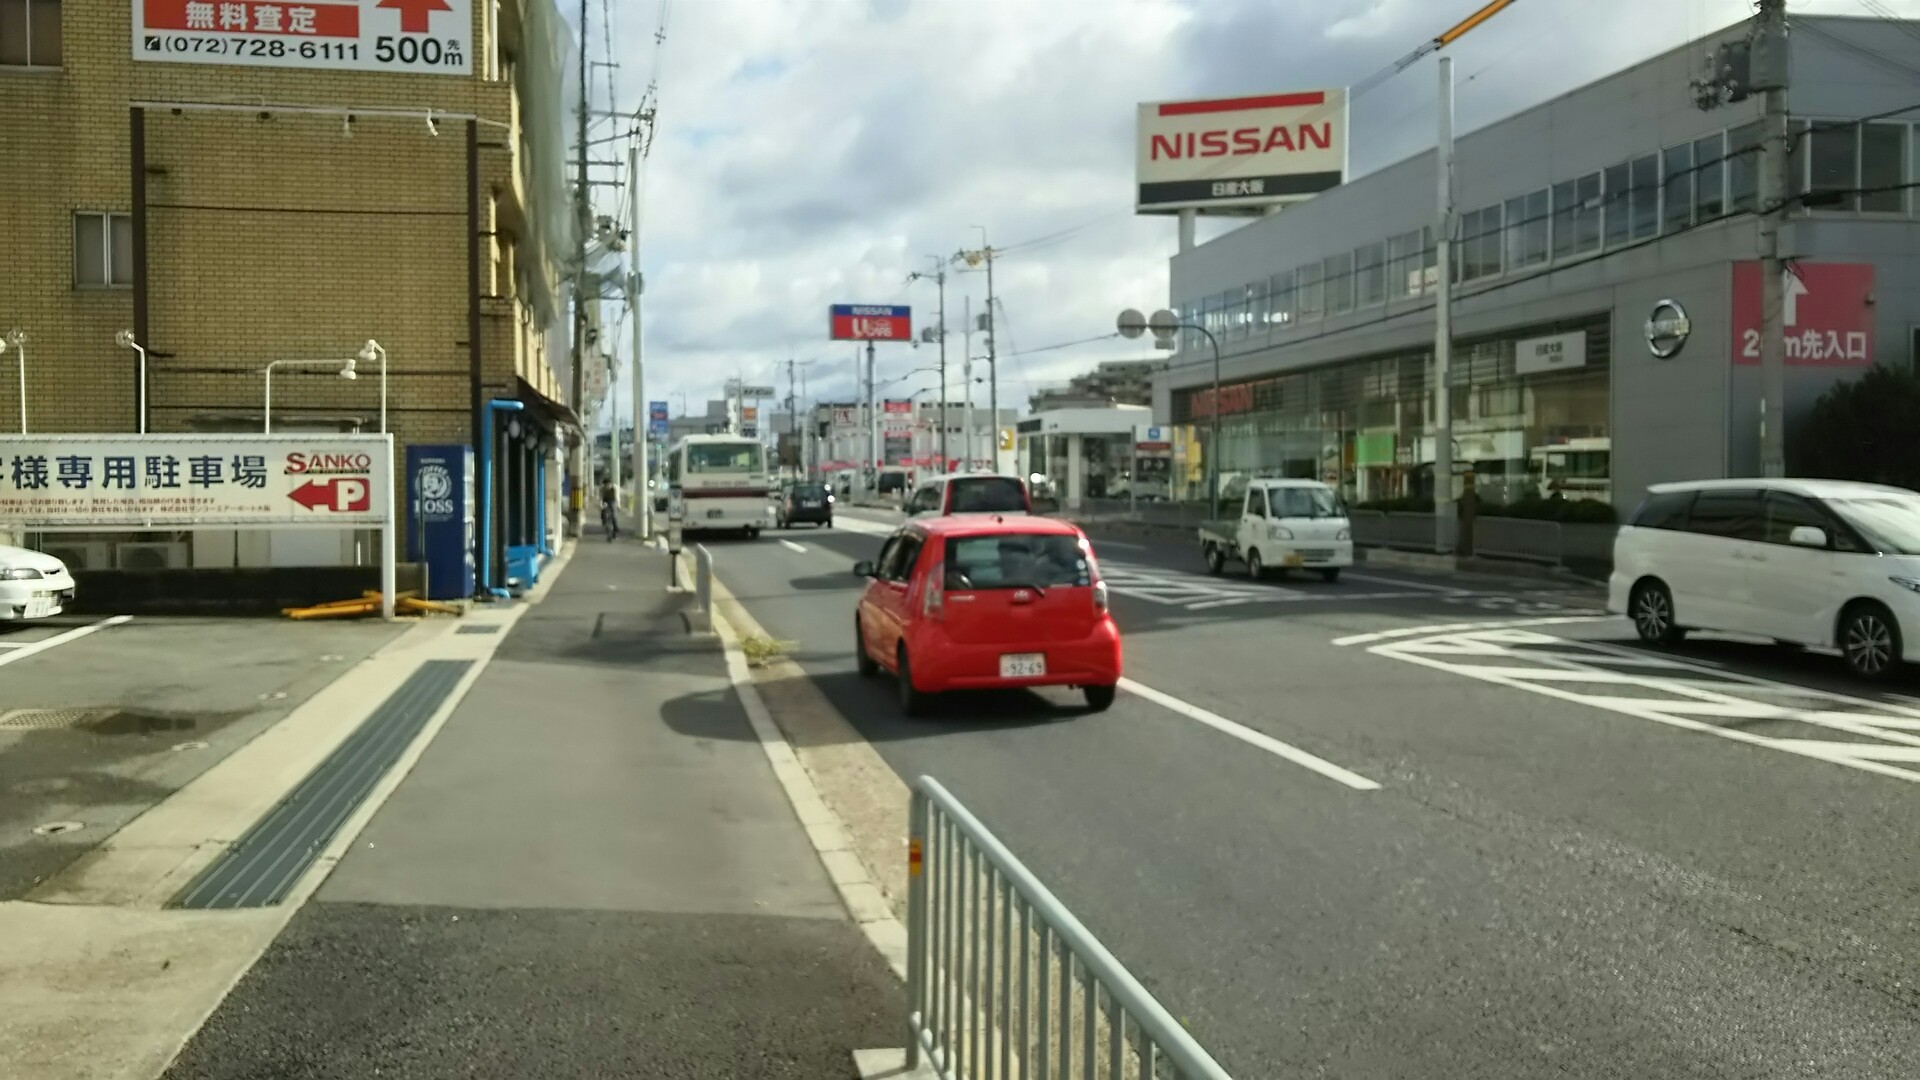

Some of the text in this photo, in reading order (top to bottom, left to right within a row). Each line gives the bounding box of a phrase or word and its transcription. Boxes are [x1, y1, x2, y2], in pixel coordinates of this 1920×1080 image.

[185, 1, 318, 34] 無料査定
[165, 36, 360, 61] (072)728-6111
[1151, 122, 1330, 162] NISSAN
[1743, 328, 1867, 360] 2m先入口
[0, 455, 268, 490] 様専用駐車場
[285, 451, 372, 473] SANKO
[337, 480, 366, 511] P
